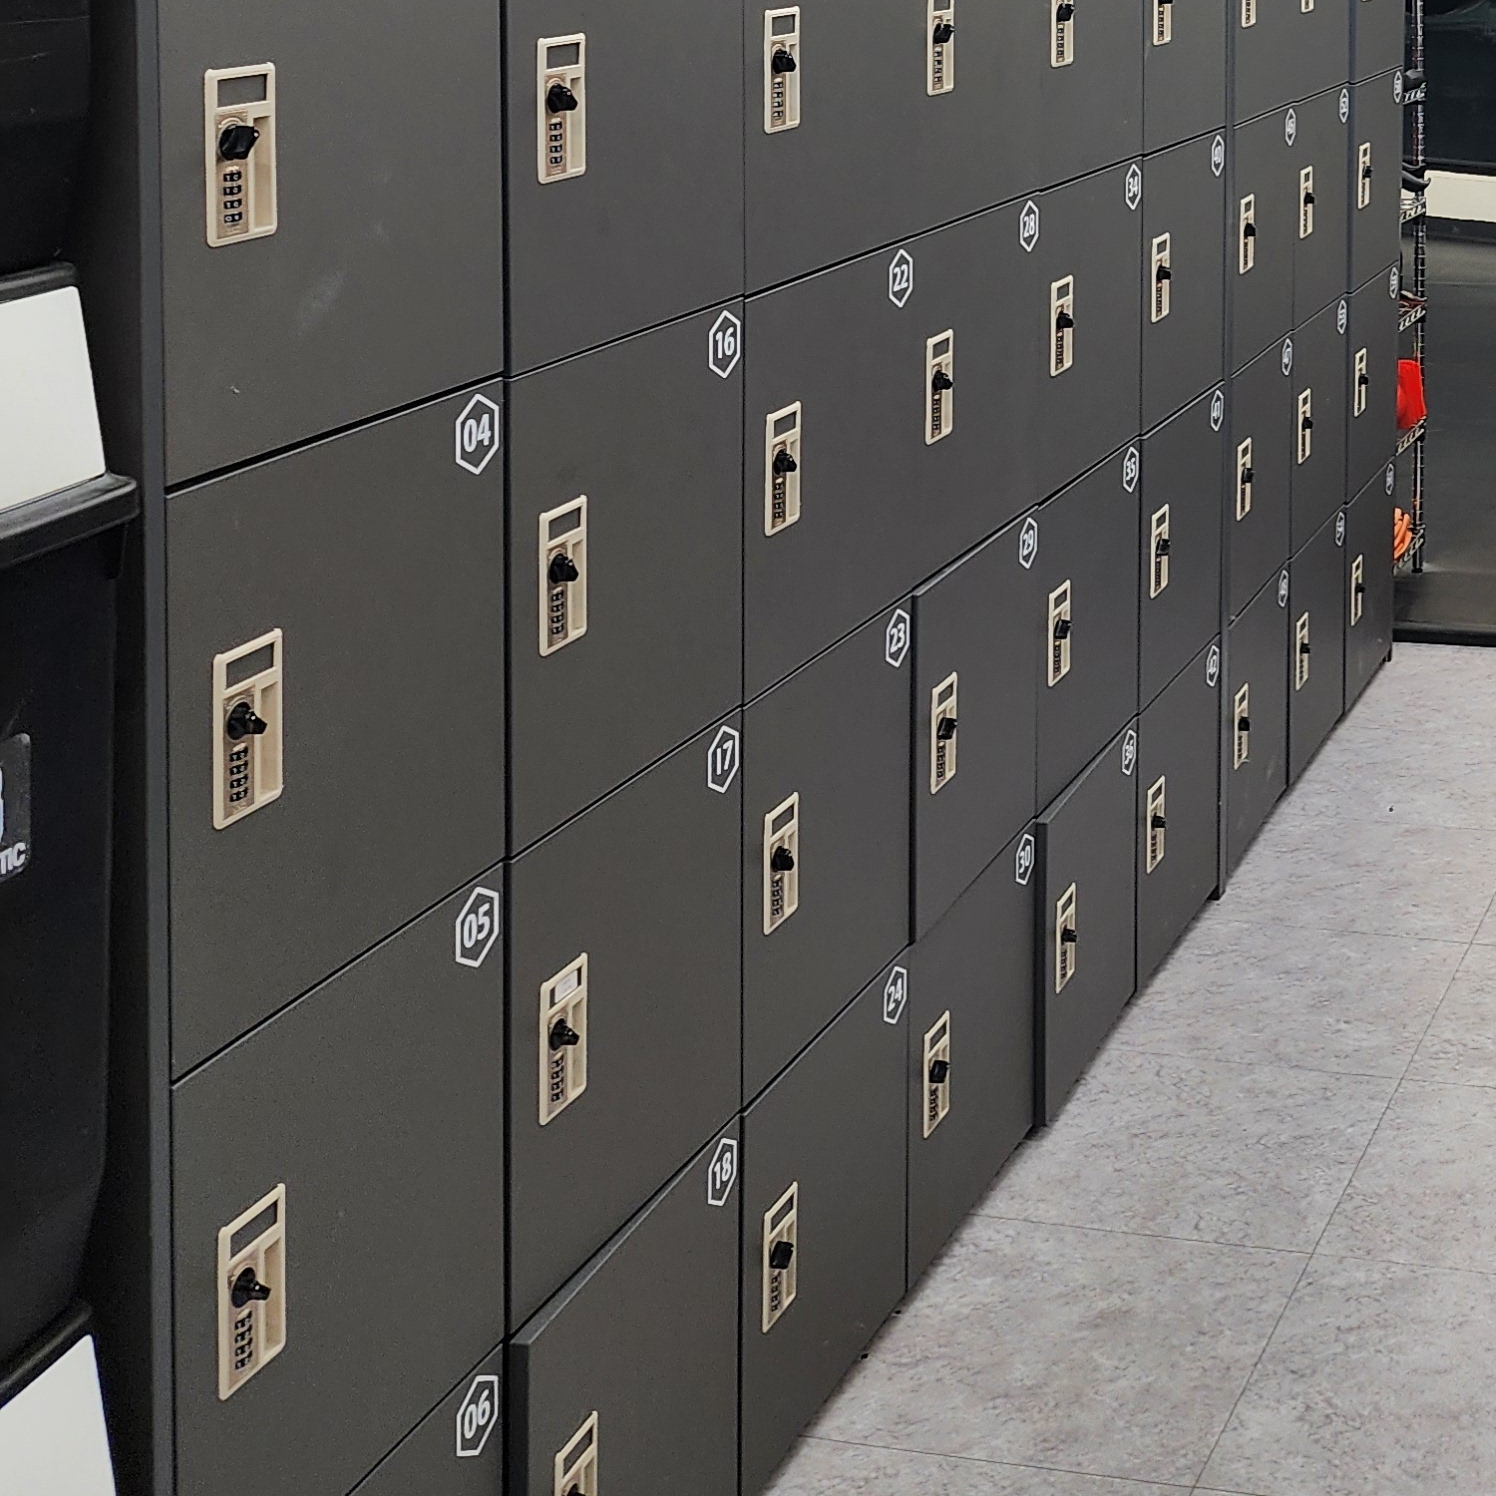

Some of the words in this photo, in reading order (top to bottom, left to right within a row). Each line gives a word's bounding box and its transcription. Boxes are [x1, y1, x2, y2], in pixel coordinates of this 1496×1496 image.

[1023, 213, 1035, 237] 28
[893, 264, 908, 292] 22
[716, 329, 735, 358] 16
[463, 414, 491, 452] 04
[1125, 457, 1136, 481] 35
[1022, 531, 1034, 555] 29
[890, 623, 906, 653] 23
[716, 740, 733, 775] 17
[1019, 846, 1031, 874] 30
[464, 904, 490, 947] 05
[888, 977, 903, 1012] 24
[713, 1151, 732, 1188] 18
[464, 1392, 489, 1437] 06
